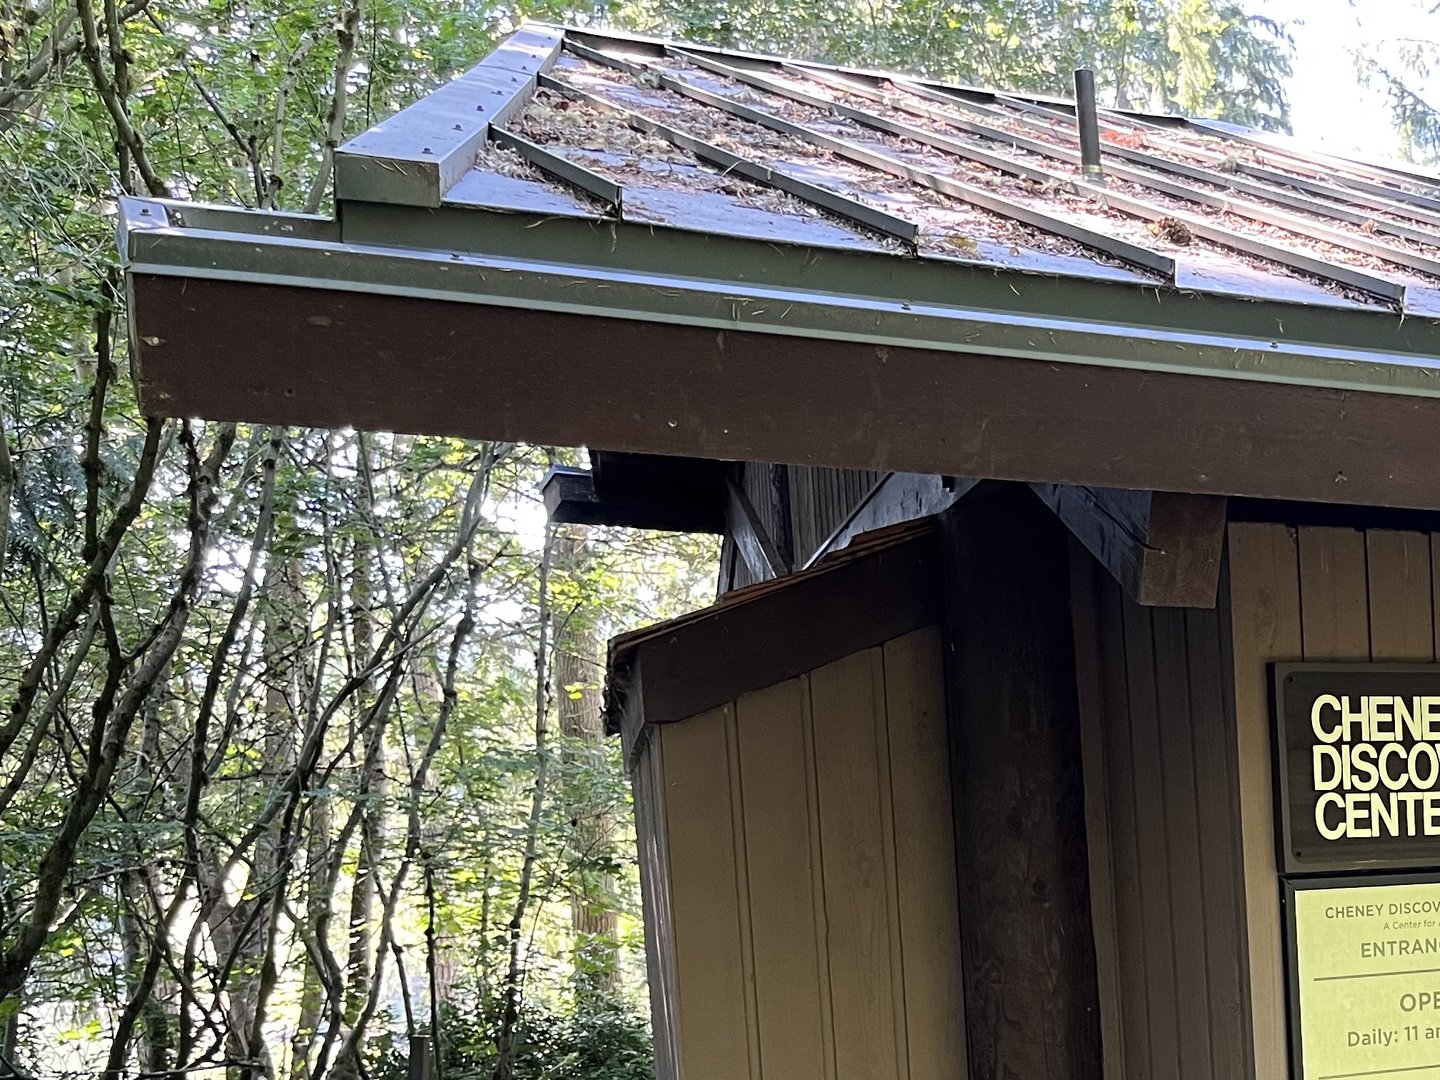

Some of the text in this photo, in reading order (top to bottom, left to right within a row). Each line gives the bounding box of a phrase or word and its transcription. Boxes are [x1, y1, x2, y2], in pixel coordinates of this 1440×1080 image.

[1325, 904, 1384, 919] CHENEY
[1383, 922, 1391, 931] A
[1393, 920, 1421, 930] Center
[1423, 919, 1436, 928] for
[1347, 1027, 1399, 1047] Daily:
[1404, 1025, 1419, 1042] 11
